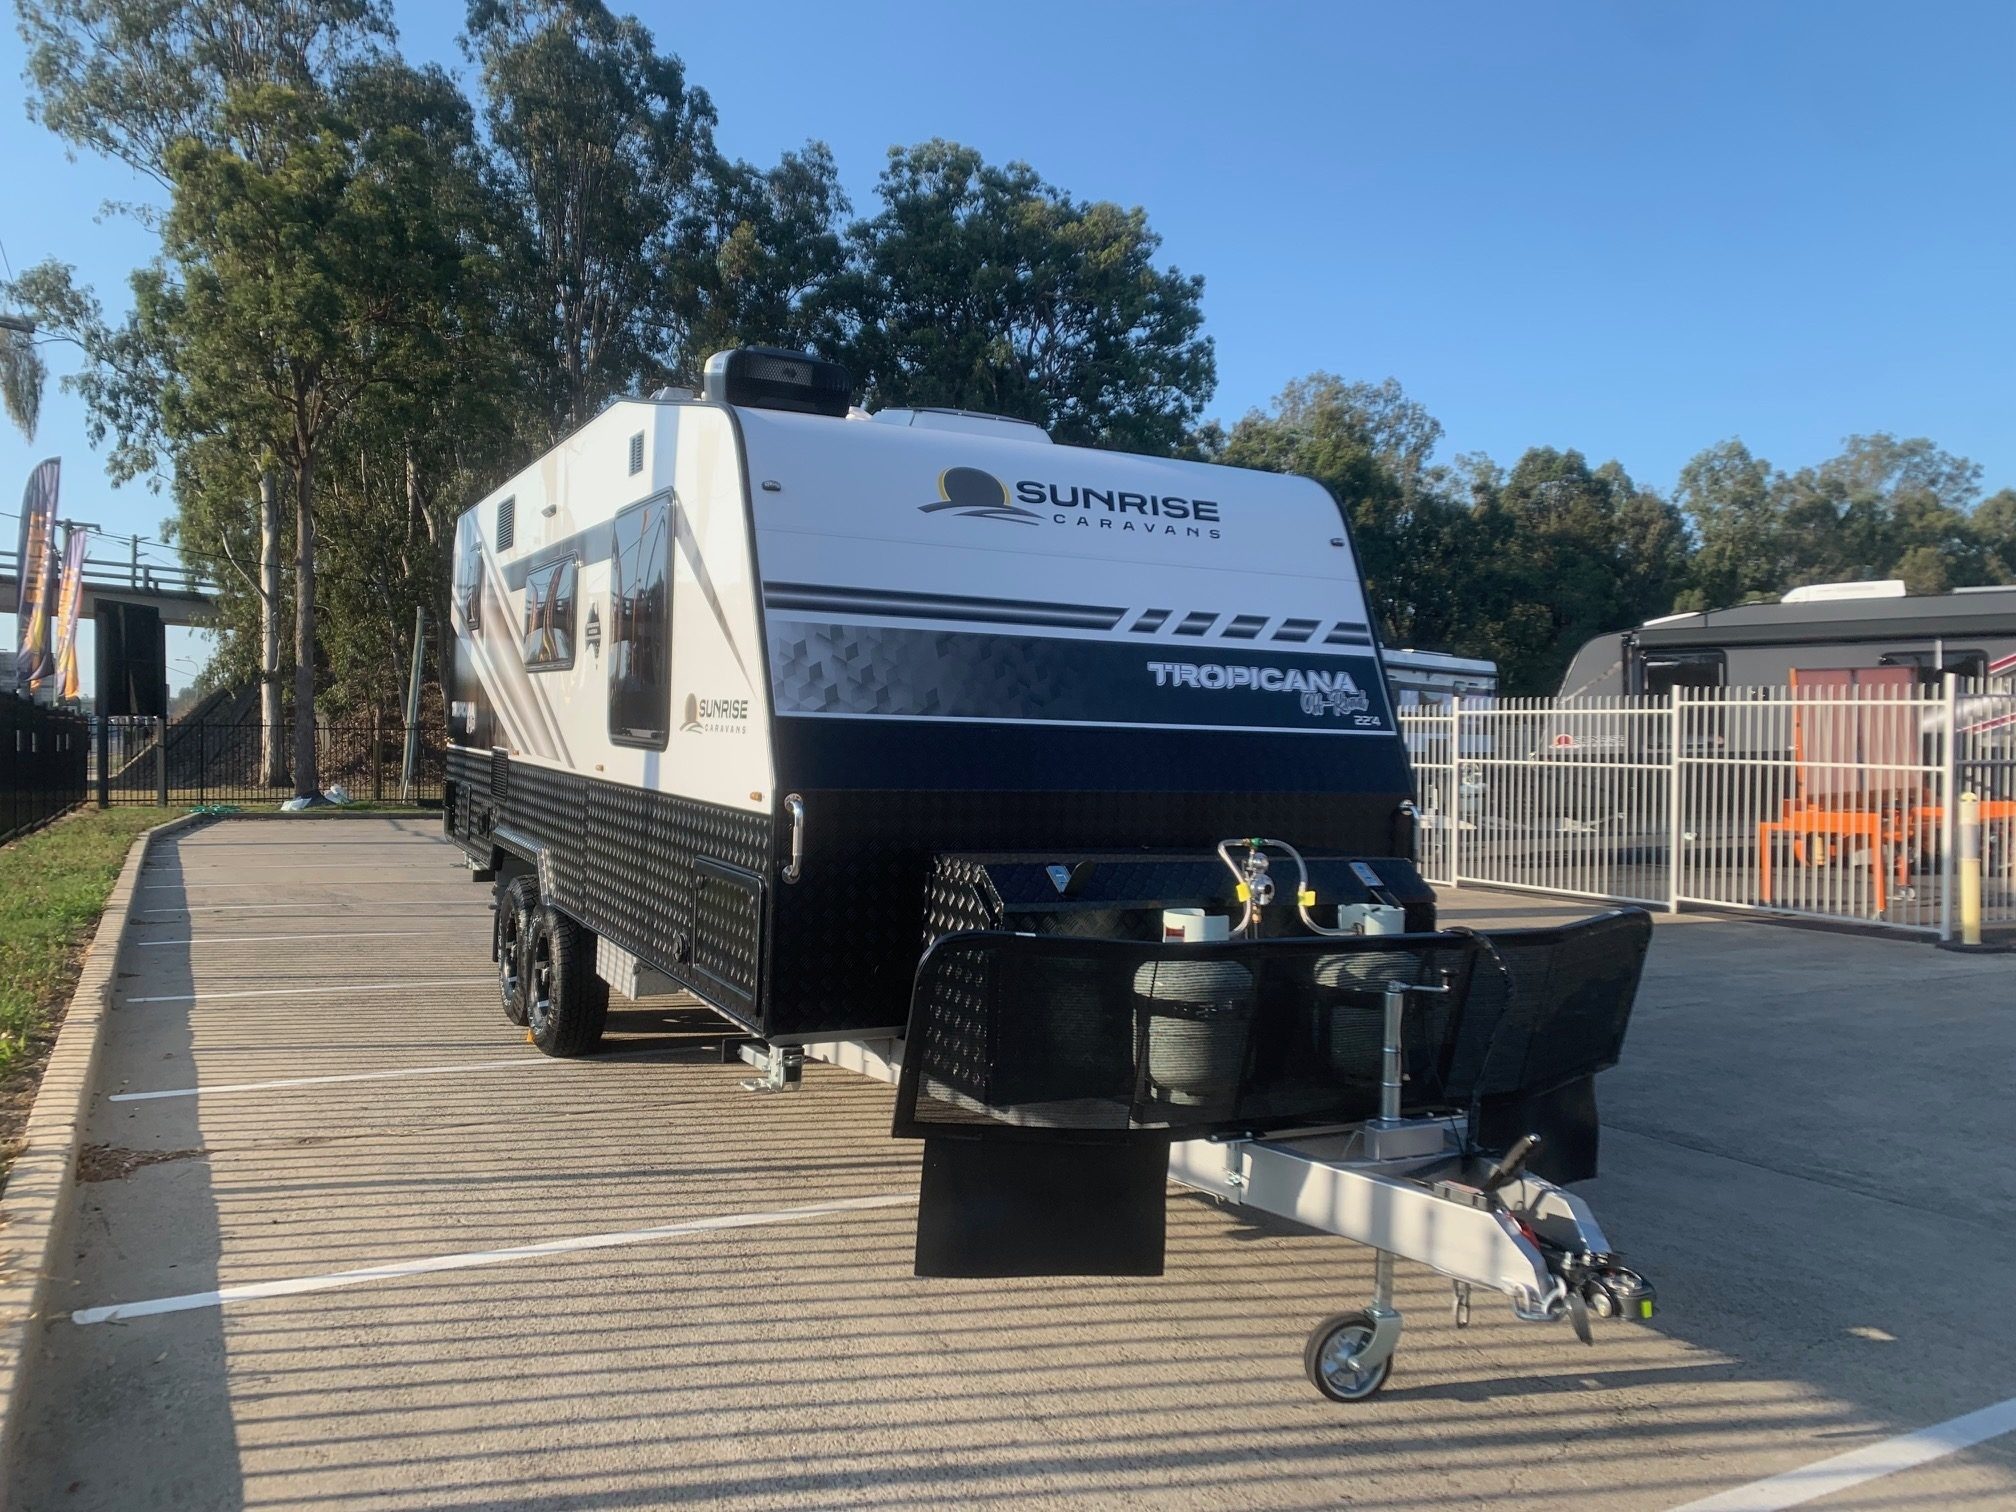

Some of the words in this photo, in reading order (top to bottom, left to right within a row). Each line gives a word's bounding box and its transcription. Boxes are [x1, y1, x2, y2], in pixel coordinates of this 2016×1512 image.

[1016, 480, 1220, 522] SUNRISE
[1053, 514, 1220, 539] CARAVANS
[1147, 661, 1359, 695] TROPICANA
[699, 699, 748, 719] SUNRISE
[704, 723, 746, 735] CARAVANS
